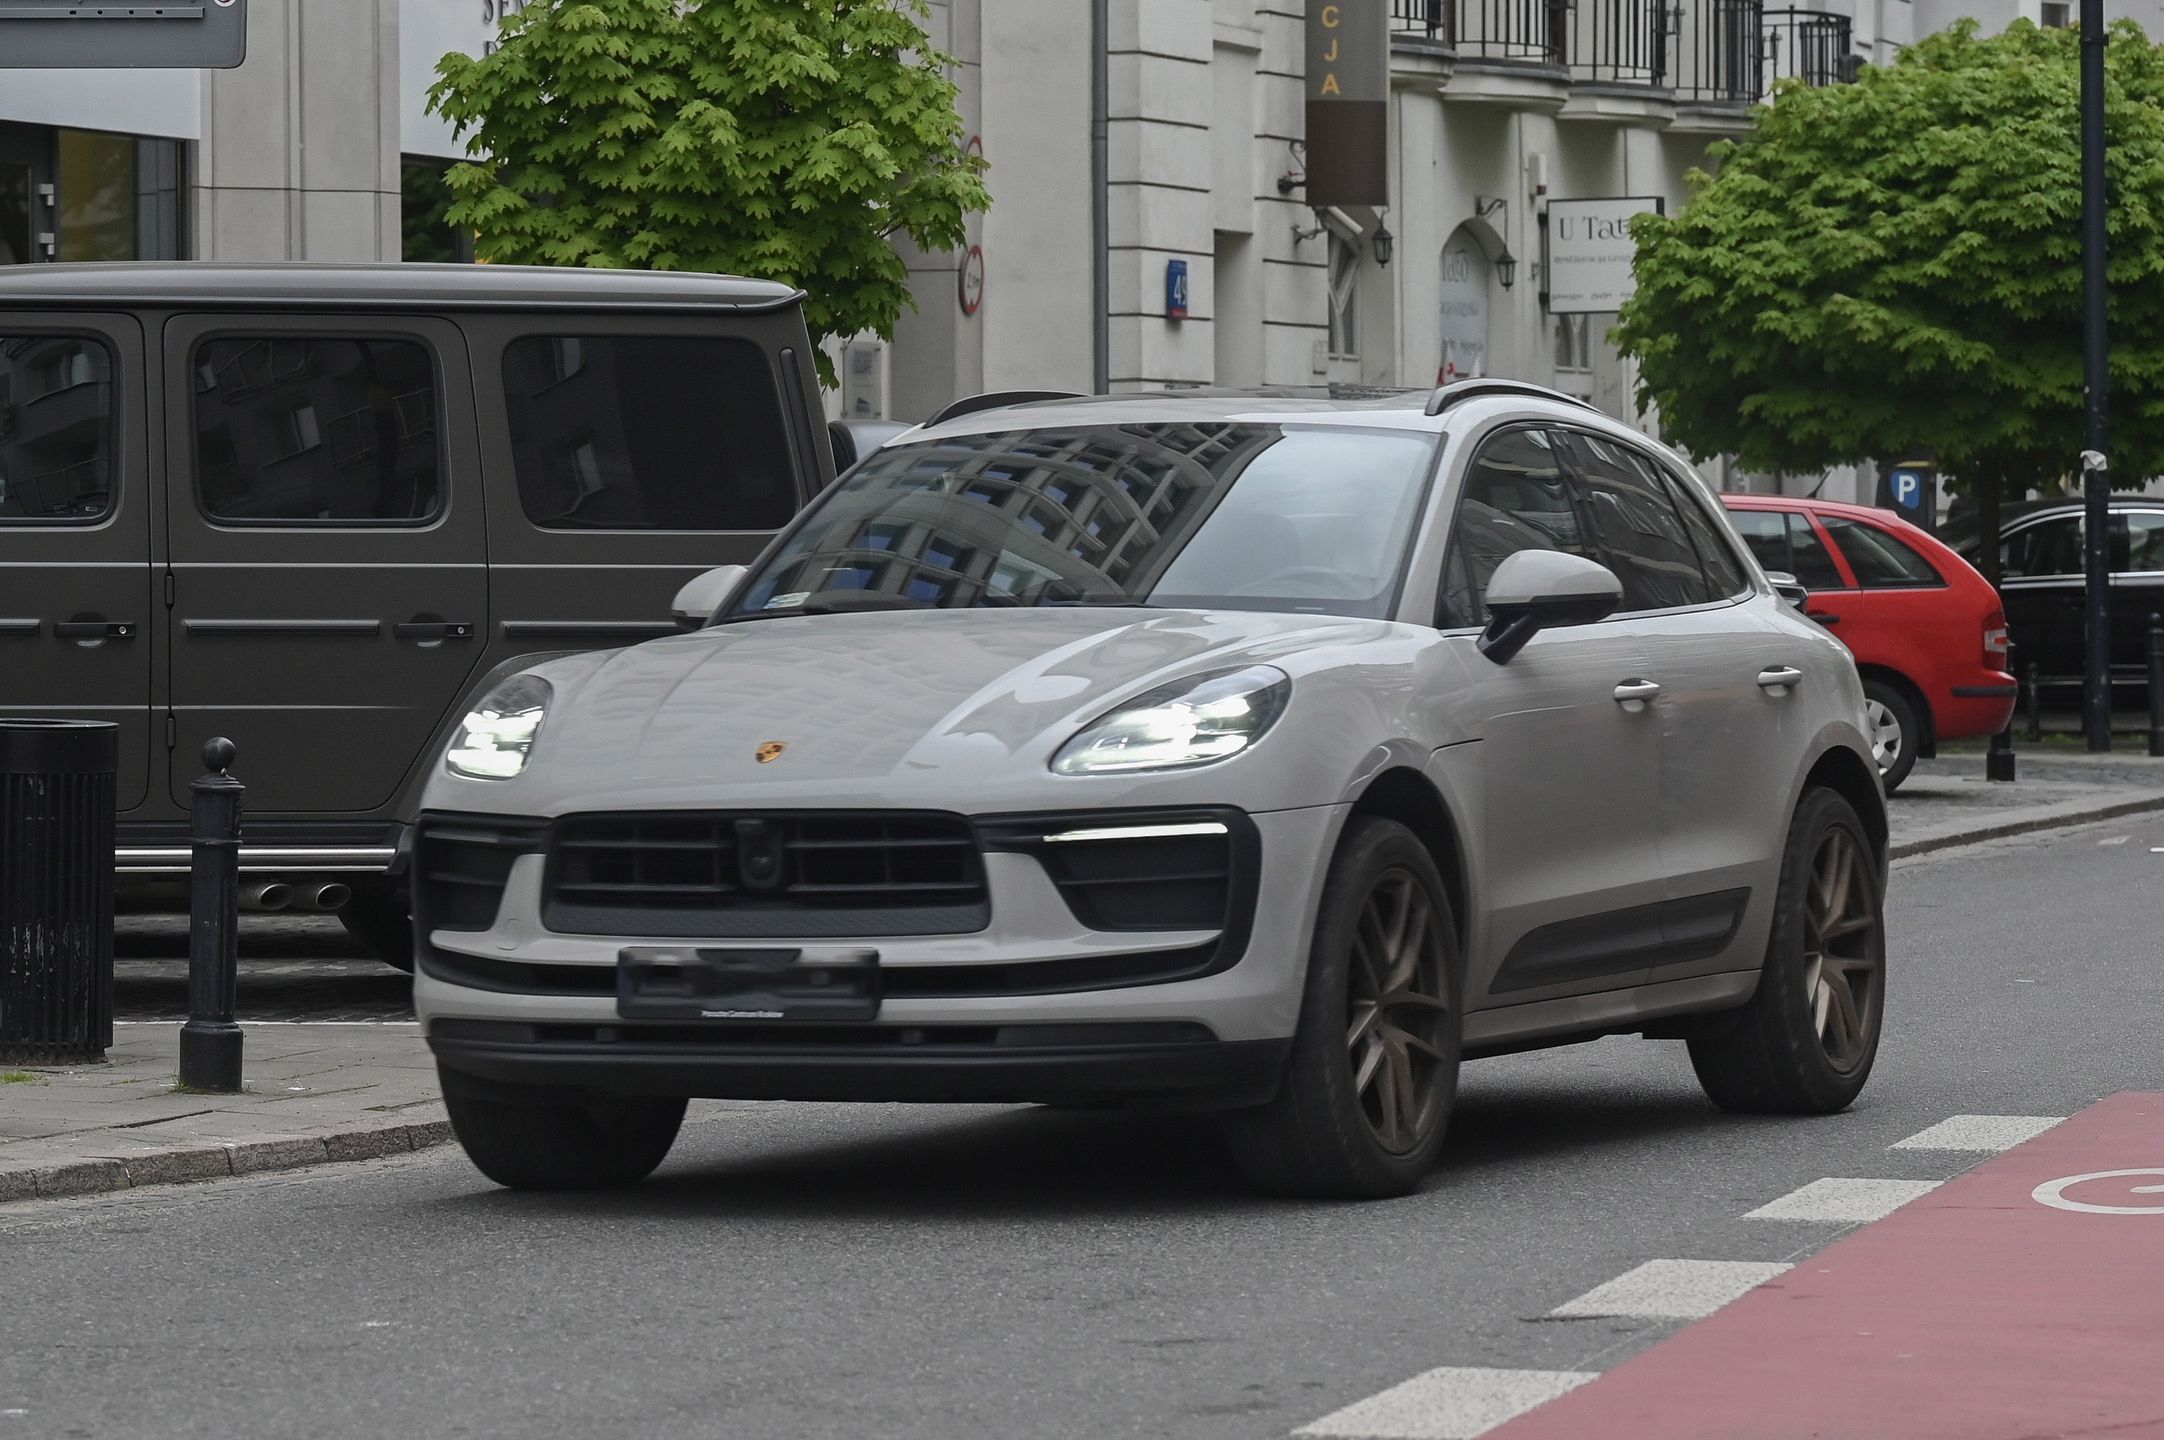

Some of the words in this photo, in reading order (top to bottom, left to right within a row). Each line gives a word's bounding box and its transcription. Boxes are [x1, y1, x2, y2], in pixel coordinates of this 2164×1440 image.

[1560, 216, 1574, 240] U
[1582, 215, 1631, 240] Tat
[1899, 474, 1916, 503] P
